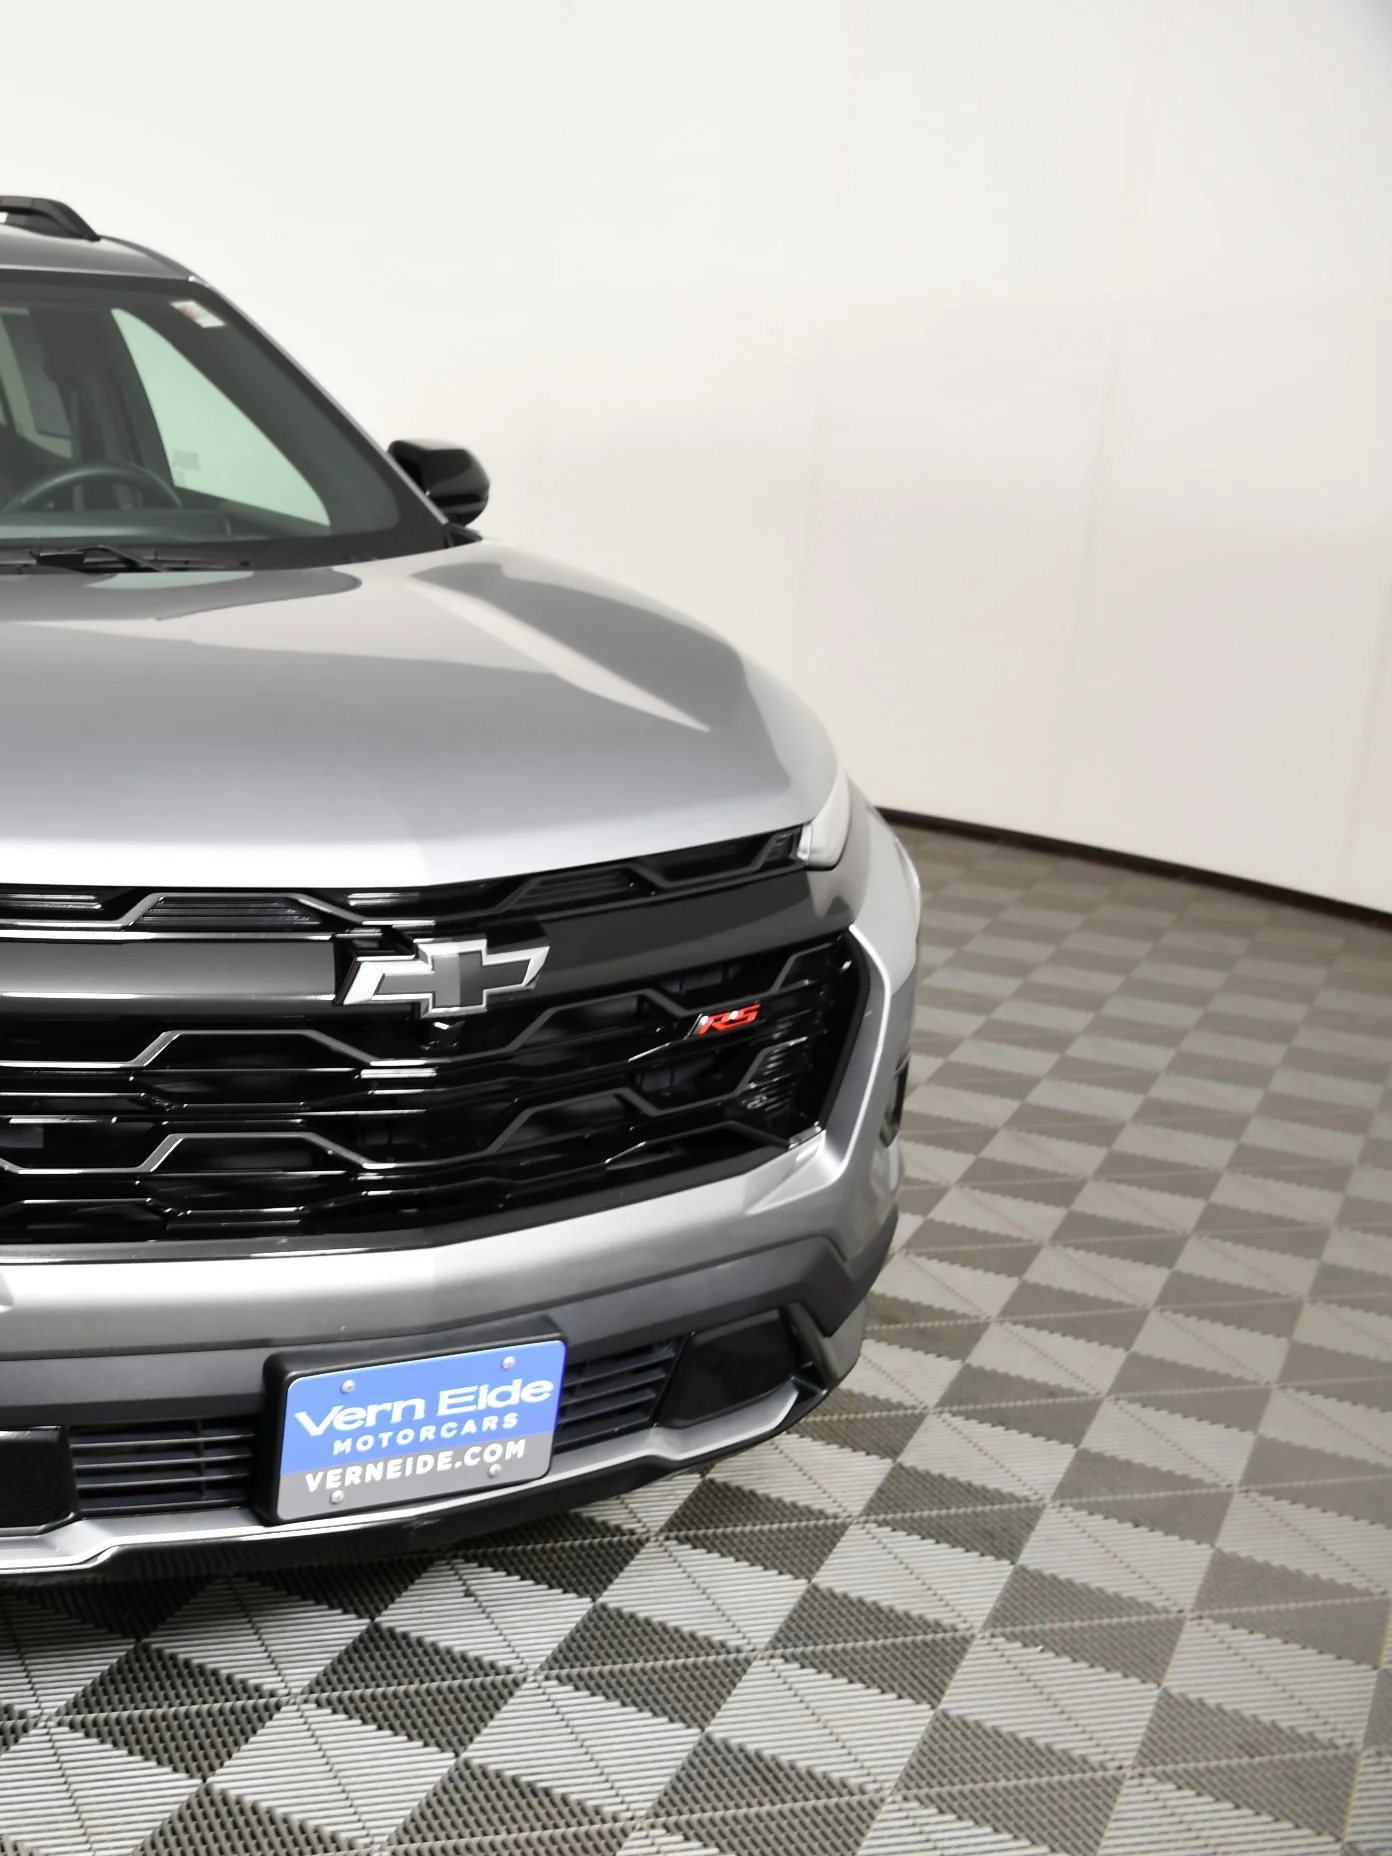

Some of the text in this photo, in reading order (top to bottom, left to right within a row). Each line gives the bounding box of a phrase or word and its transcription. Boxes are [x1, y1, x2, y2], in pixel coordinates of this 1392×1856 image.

[698, 1004, 760, 1035] RS
[295, 1379, 554, 1437] Vern Eide
[333, 1412, 519, 1456] MOTORCARS
[305, 1439, 526, 1492] VERNEIDE.COM
